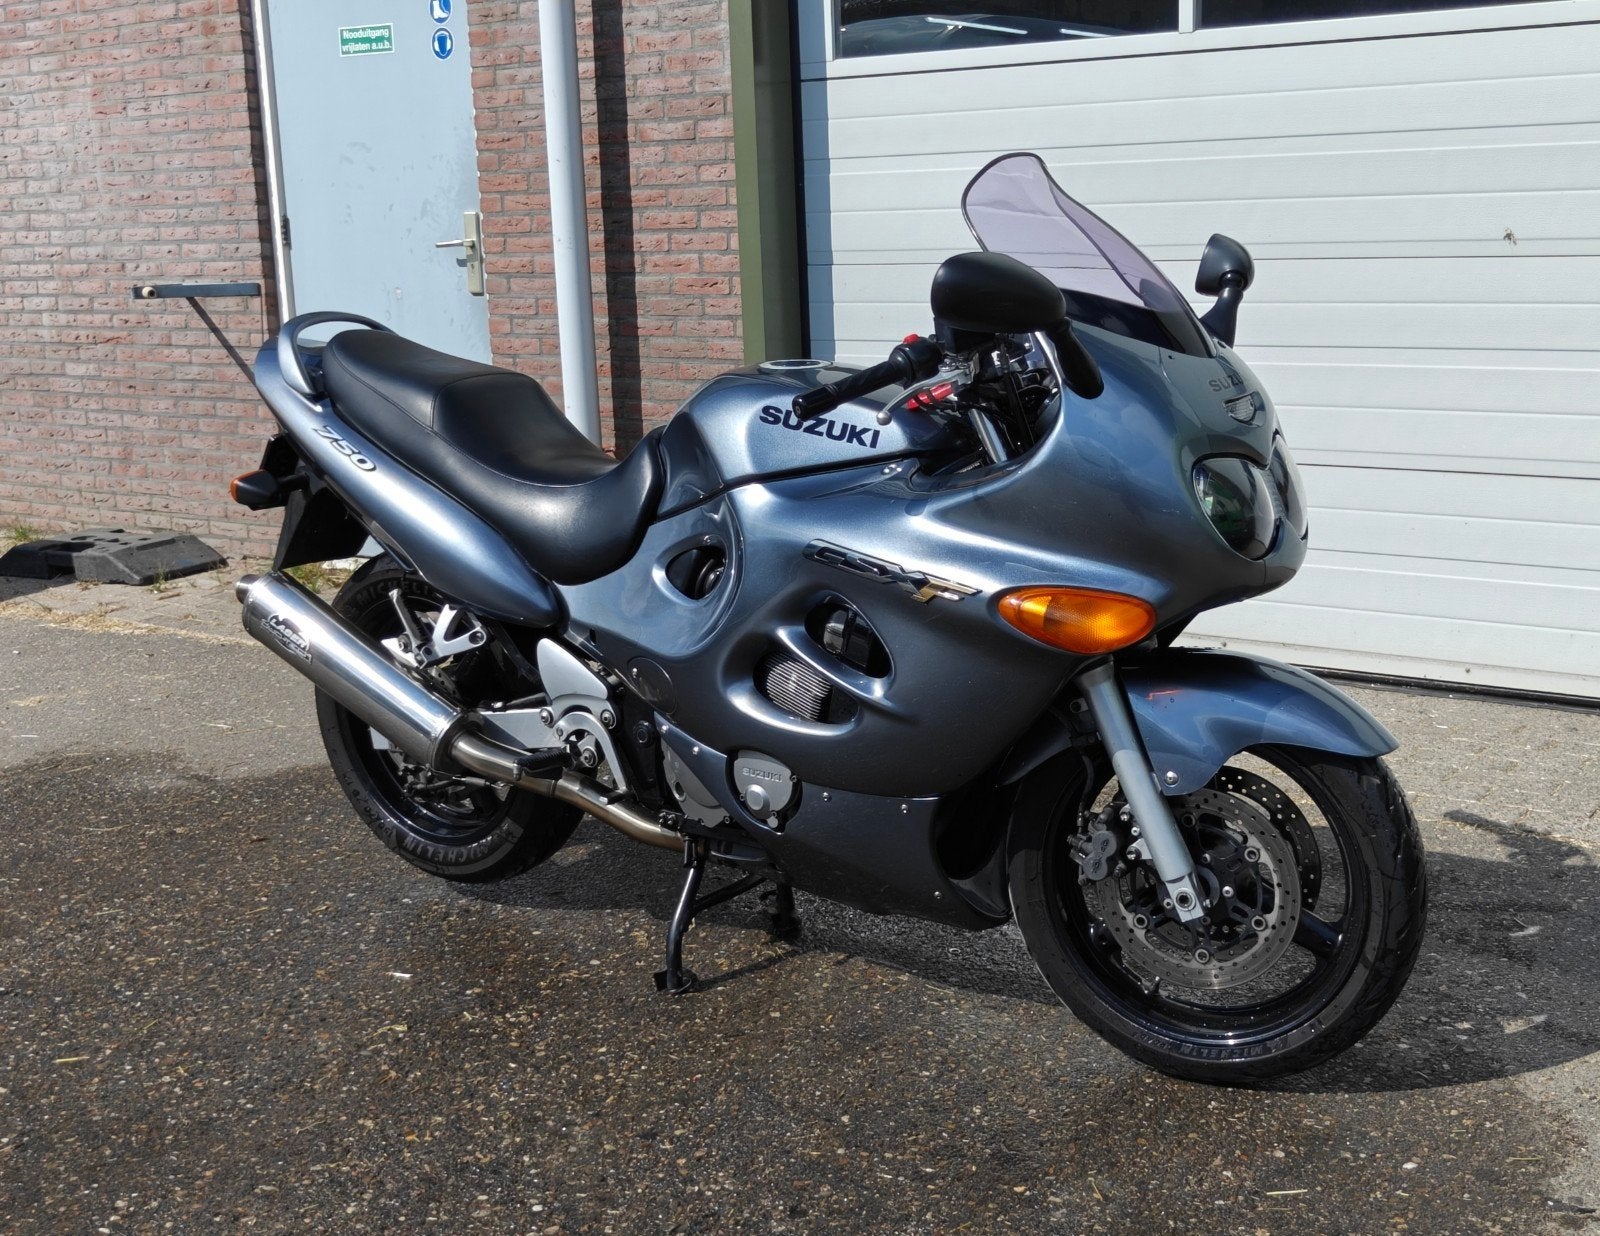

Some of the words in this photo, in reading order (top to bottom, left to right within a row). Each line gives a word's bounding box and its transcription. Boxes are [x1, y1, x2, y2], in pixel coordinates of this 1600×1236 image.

[342, 28, 389, 39] Nooduitgang
[341, 43, 371, 54] vrijlaten
[371, 41, 392, 50] a.u.b.
[759, 404, 881, 449] SUZUKI
[311, 424, 378, 472] 750
[742, 767, 783, 783] SUZUKI
